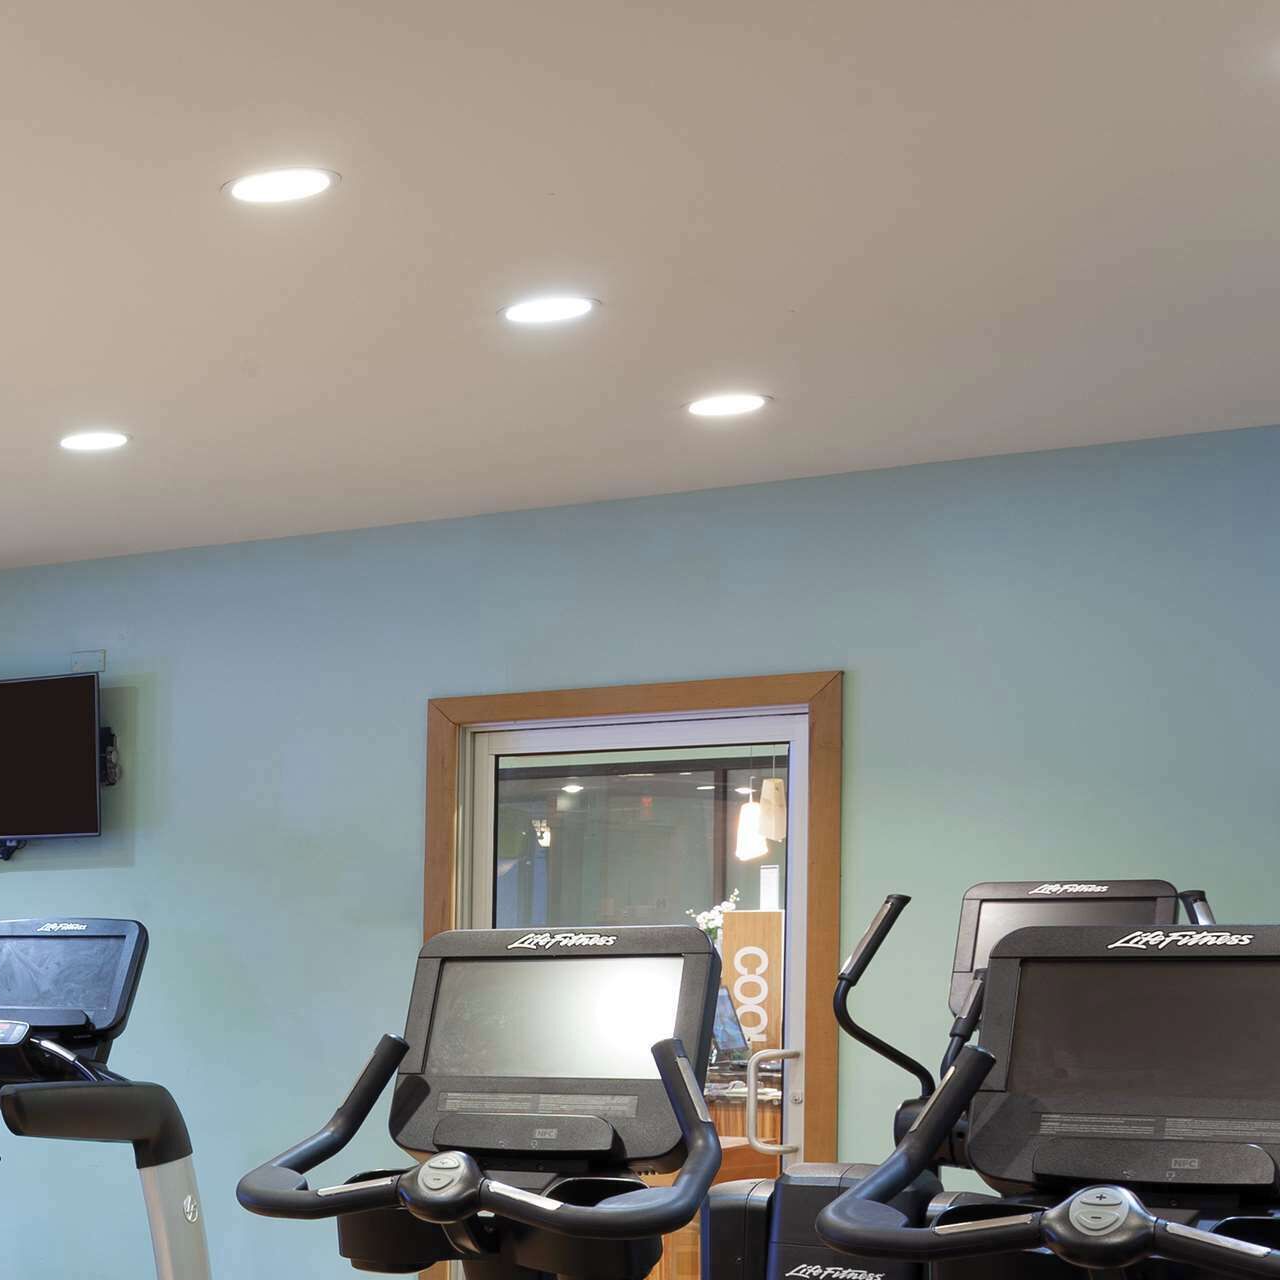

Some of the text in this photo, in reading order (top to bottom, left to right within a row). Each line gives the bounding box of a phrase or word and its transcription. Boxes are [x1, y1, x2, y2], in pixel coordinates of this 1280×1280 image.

[506, 932, 618, 950] LifeFitness
[1106, 931, 1254, 950] LifeFitness
[785, 1264, 885, 1280] LifeFitness
